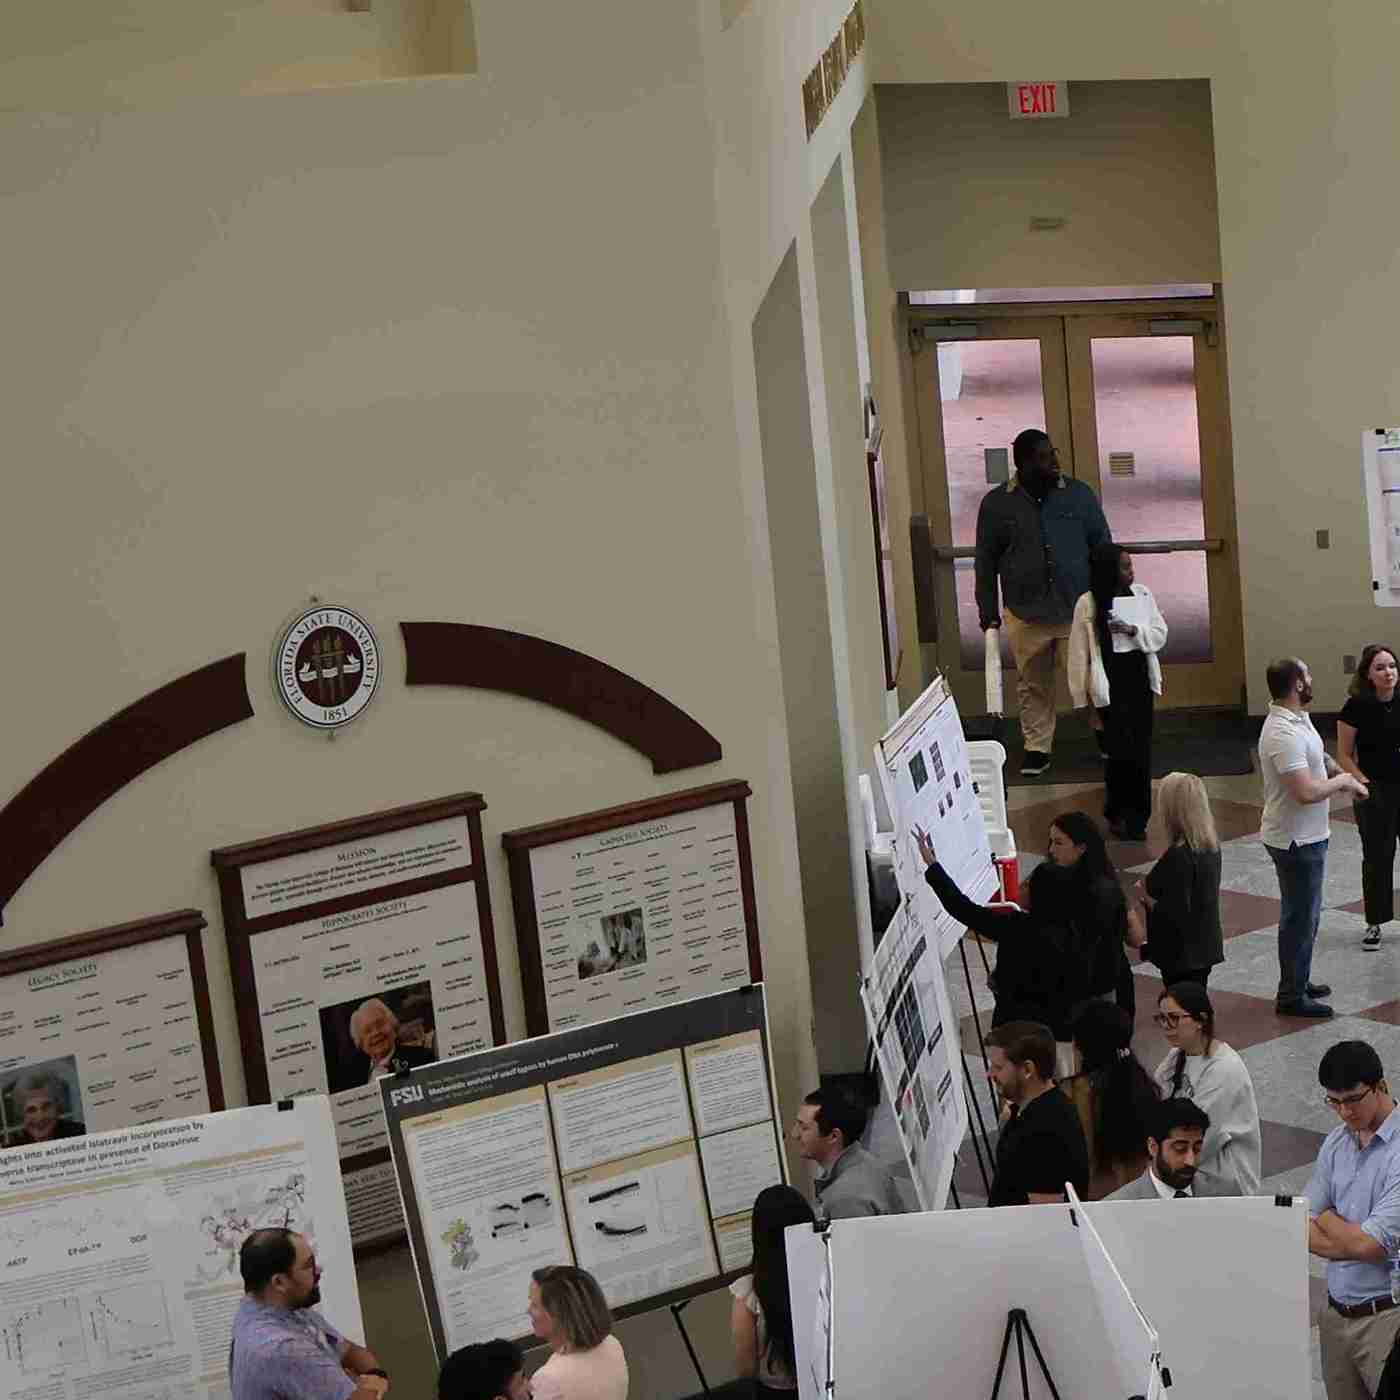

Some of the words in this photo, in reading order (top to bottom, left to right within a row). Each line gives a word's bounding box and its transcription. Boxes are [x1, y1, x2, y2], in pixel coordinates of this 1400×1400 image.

[1018, 85, 1056, 113] EXIT
[338, 614, 376, 690] UNIVERSITY
[323, 706, 348, 721] 1851
[389, 1084, 424, 1107] FSU
